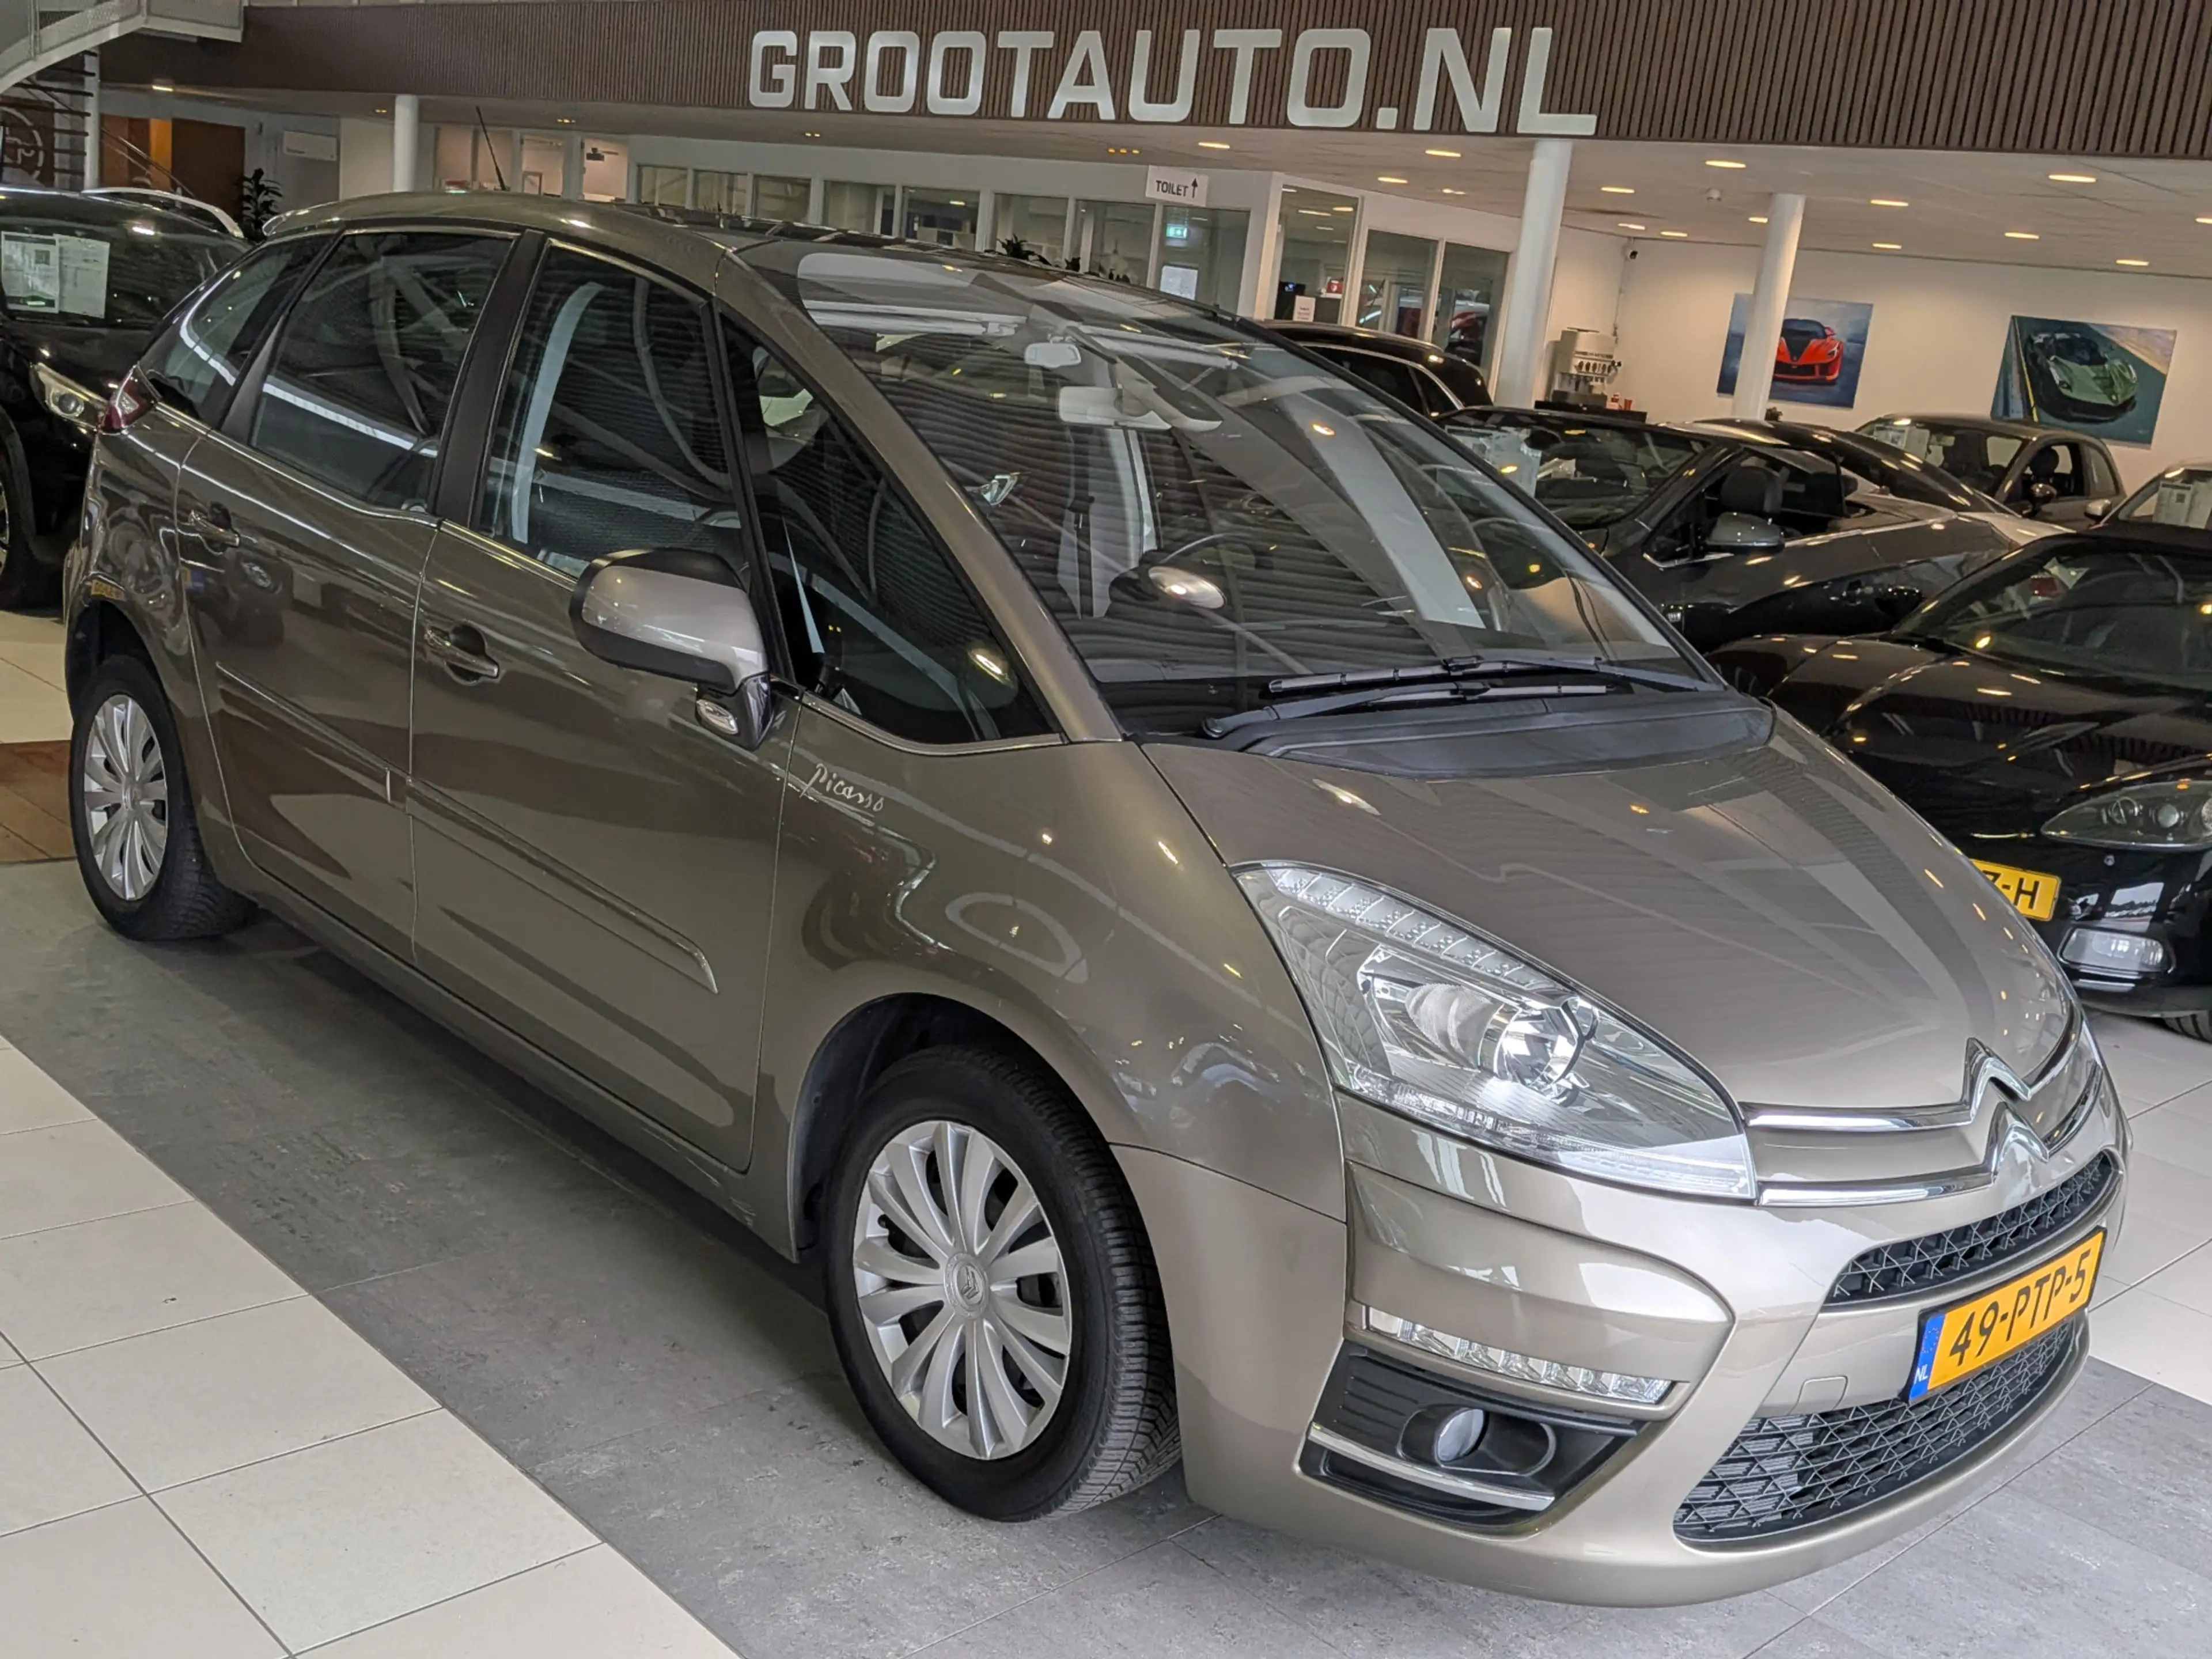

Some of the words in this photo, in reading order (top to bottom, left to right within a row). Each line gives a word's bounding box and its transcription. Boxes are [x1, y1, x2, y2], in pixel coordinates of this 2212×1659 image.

[749, 27, 1597, 135] GROOTAUTO.NL
[1156, 180, 1189, 197] TOILET
[799, 763, 884, 812] Picasso
[1949, 1248, 2091, 1367] 49-PTP-5
[1914, 1363, 1929, 1384] NL
